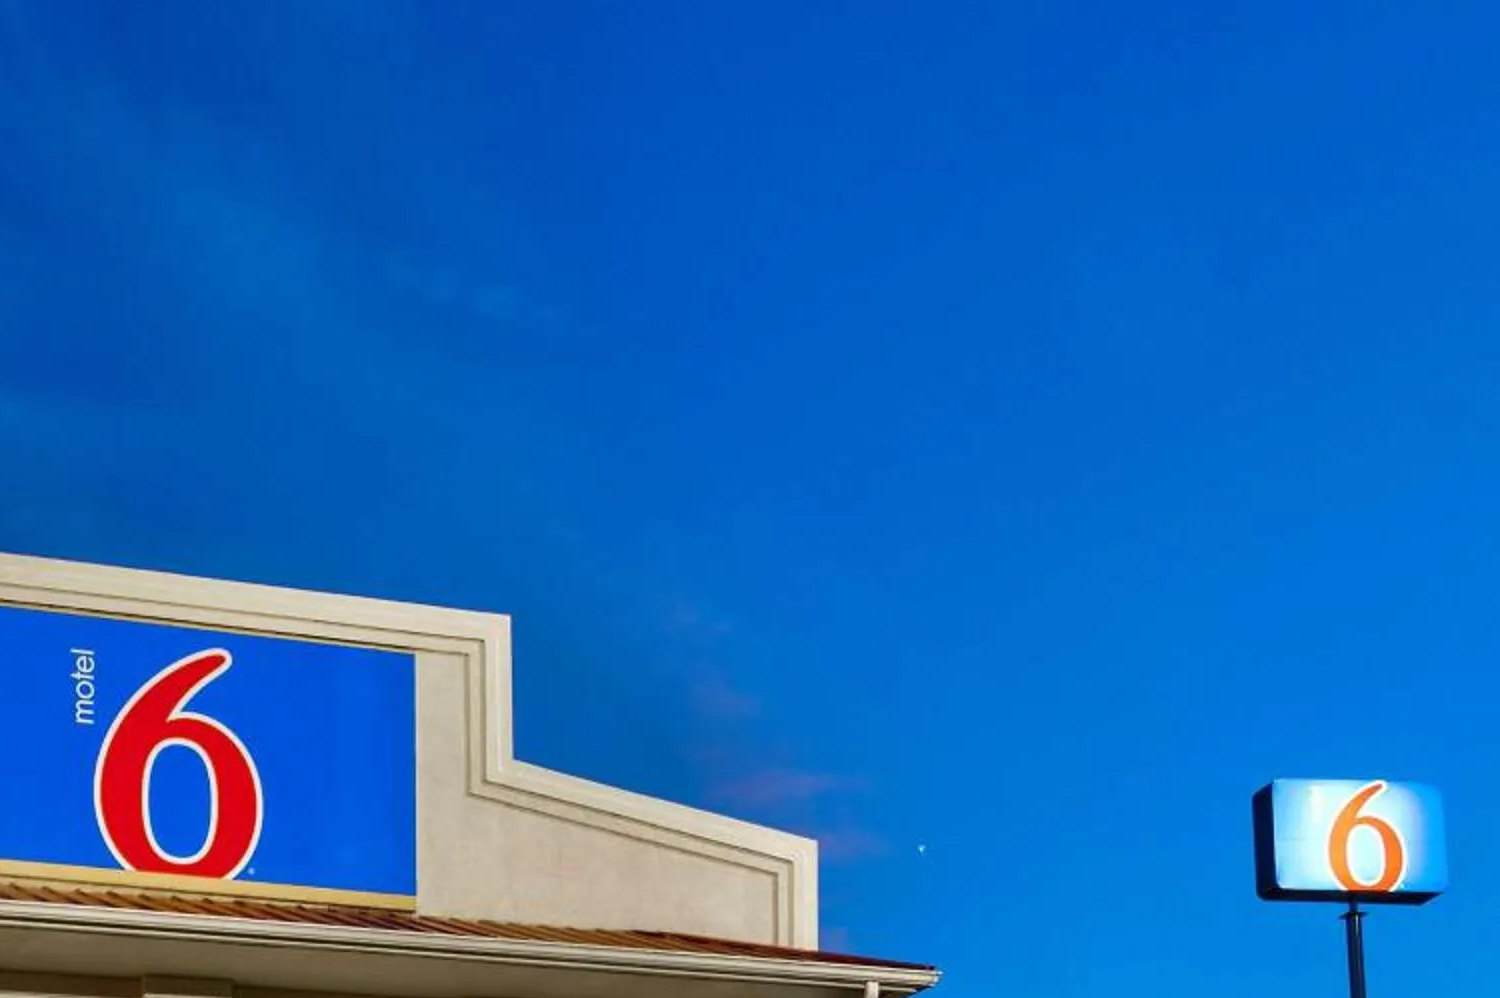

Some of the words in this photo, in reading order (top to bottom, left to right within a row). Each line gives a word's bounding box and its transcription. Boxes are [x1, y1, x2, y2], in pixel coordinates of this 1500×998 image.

[70, 648, 95, 724] motel
[94, 647, 264, 881] 6
[1326, 780, 1408, 892] 6
